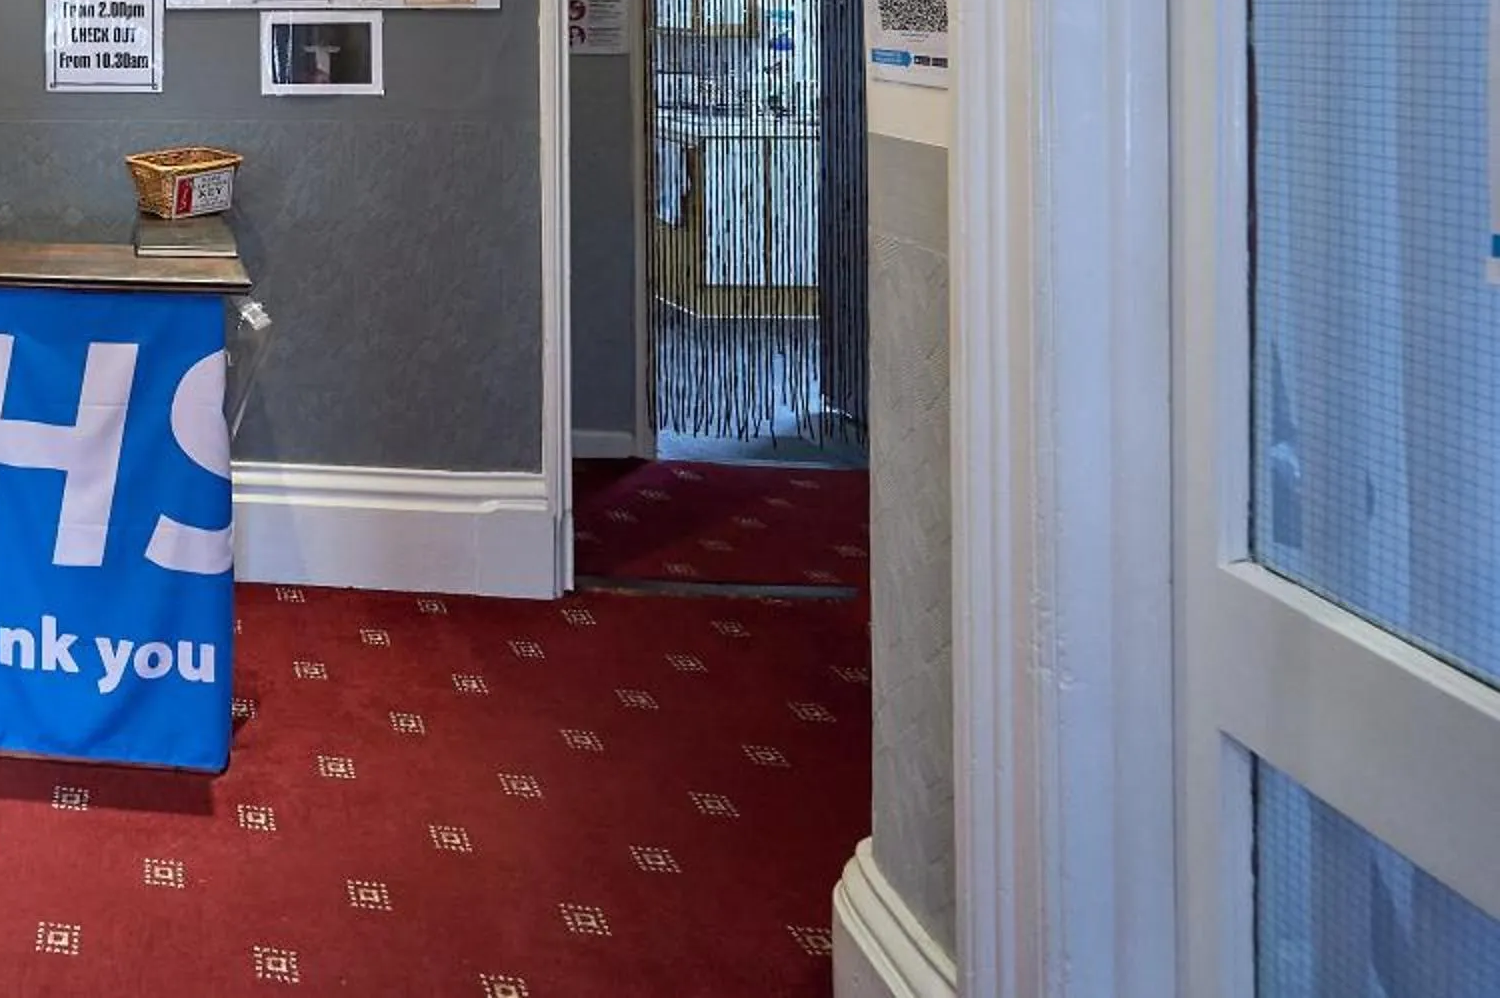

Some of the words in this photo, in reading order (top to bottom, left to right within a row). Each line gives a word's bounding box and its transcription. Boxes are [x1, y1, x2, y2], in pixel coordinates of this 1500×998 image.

[98, 1, 145, 20] 2.00pm
[71, 27, 109, 43] CHECK
[113, 27, 137, 43] OUT
[59, 51, 91, 69] From
[95, 52, 149, 69] 10.30am
[95, 639, 215, 694] you
